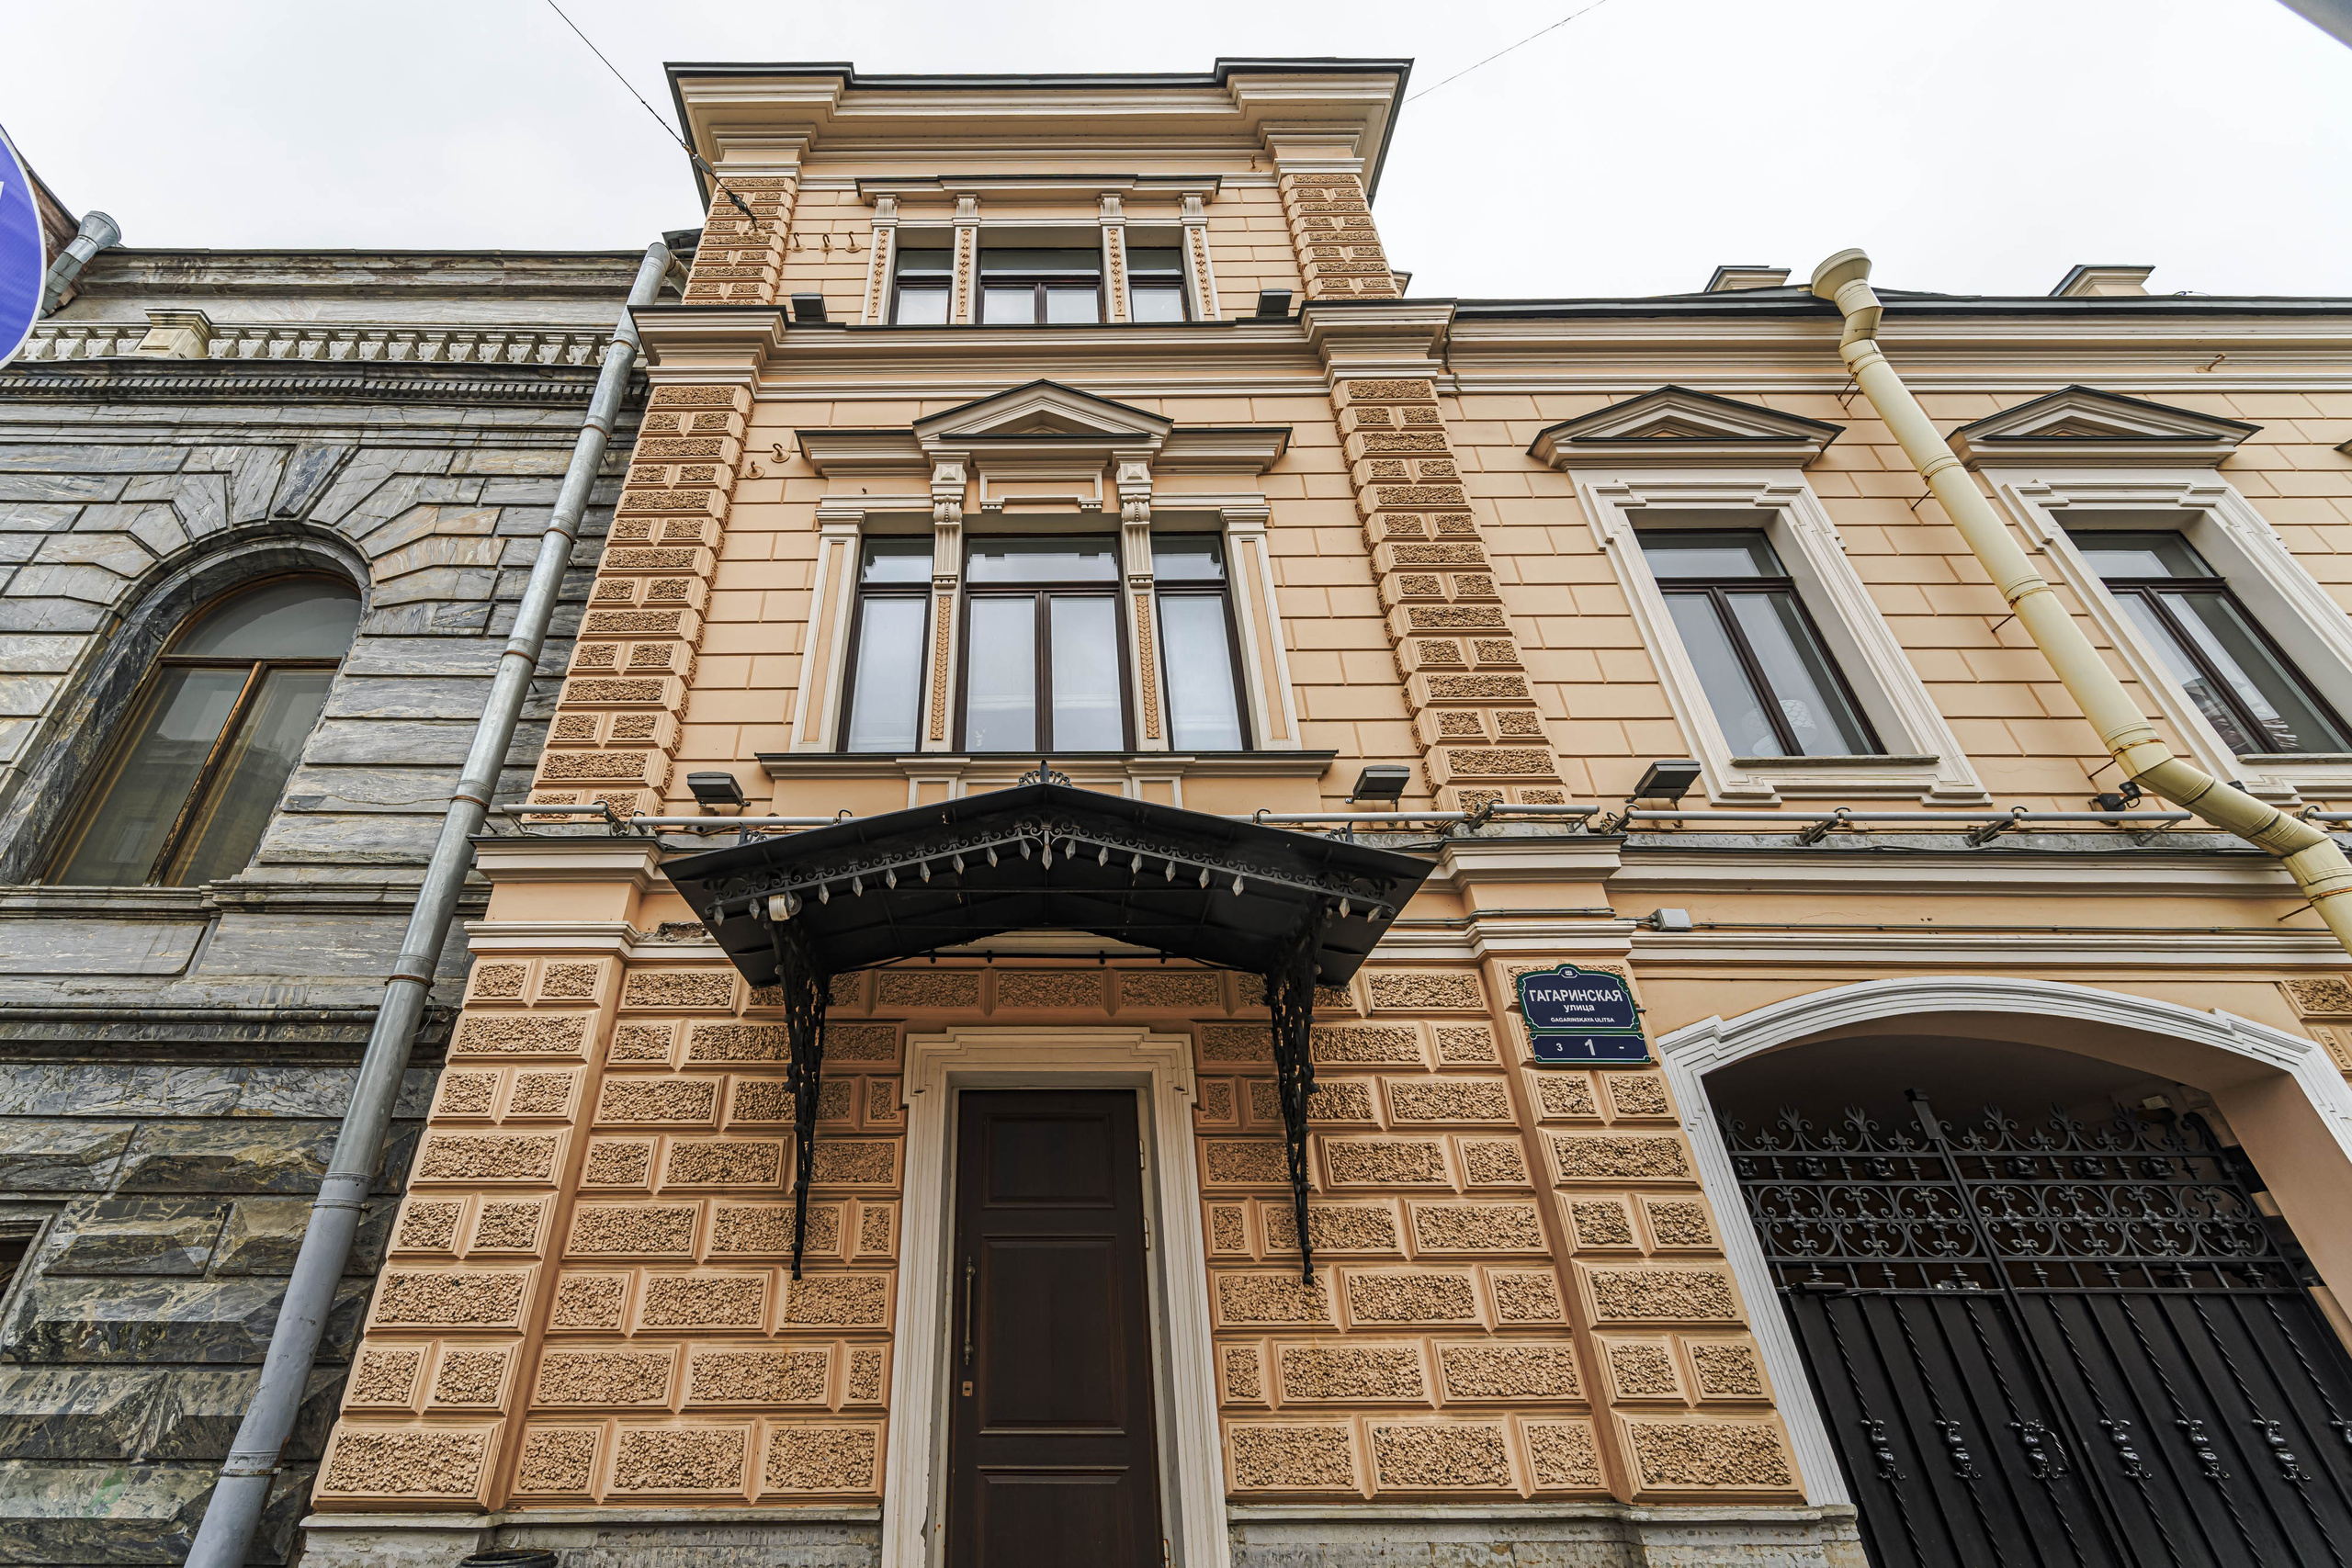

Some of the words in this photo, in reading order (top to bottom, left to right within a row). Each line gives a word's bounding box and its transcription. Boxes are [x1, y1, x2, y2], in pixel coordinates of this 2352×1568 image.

[1529, 989, 1623, 1002] ГАГАРИНСКАЯ
[1563, 1004, 1595, 1013] улица
[1555, 1043, 1564, 1052] 3
[1584, 1038, 1596, 1056] 1
